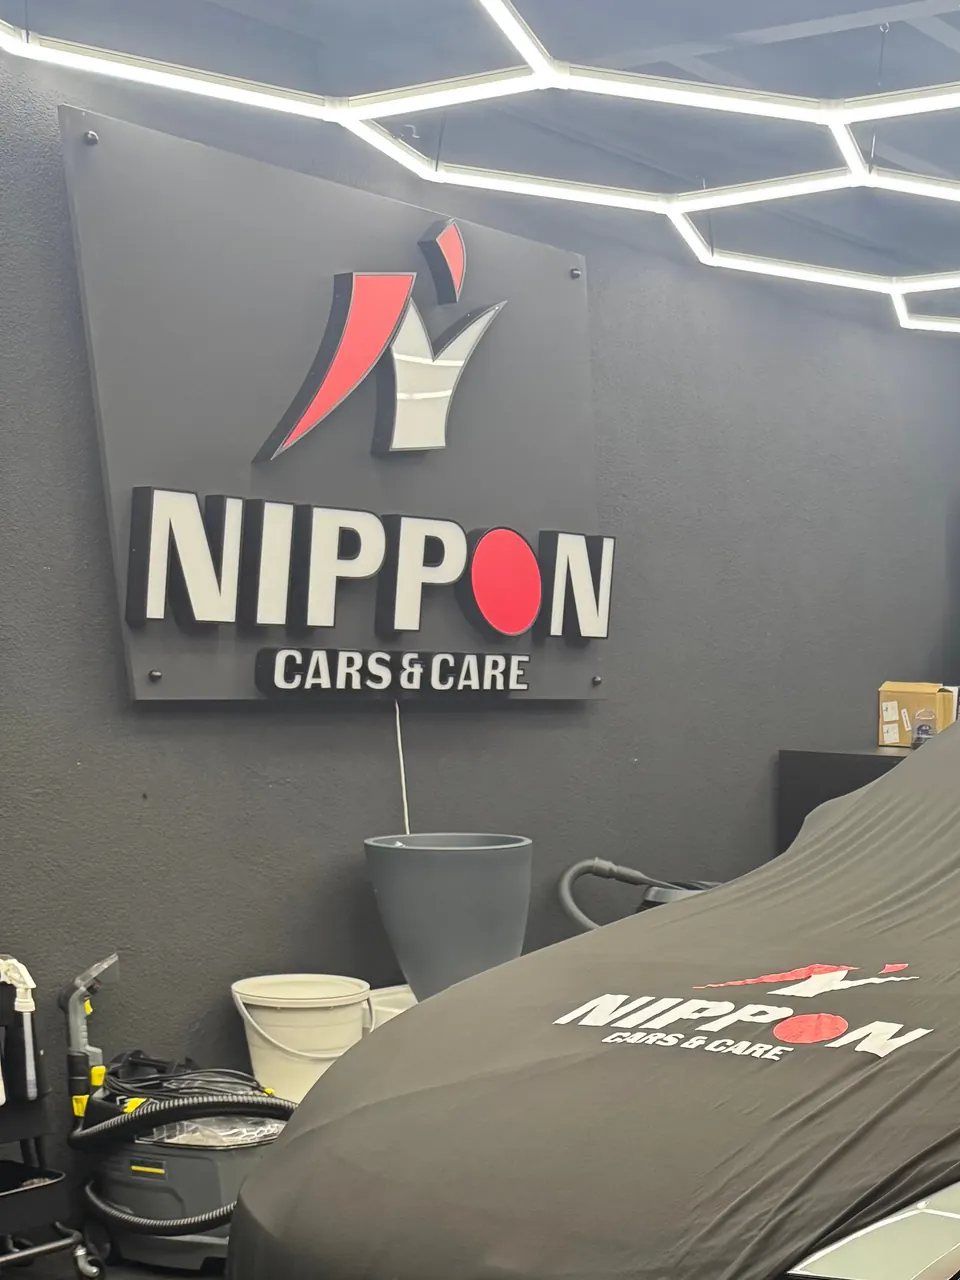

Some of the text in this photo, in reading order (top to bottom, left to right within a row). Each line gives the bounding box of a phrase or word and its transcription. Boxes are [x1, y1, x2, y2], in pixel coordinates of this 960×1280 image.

[144, 487, 616, 639] NIPPON
[273, 649, 393, 690] CARS
[430, 653, 530, 691] CARE
[552, 993, 934, 1059] NIPPON
[601, 1031, 794, 1061] CARS & CARE
